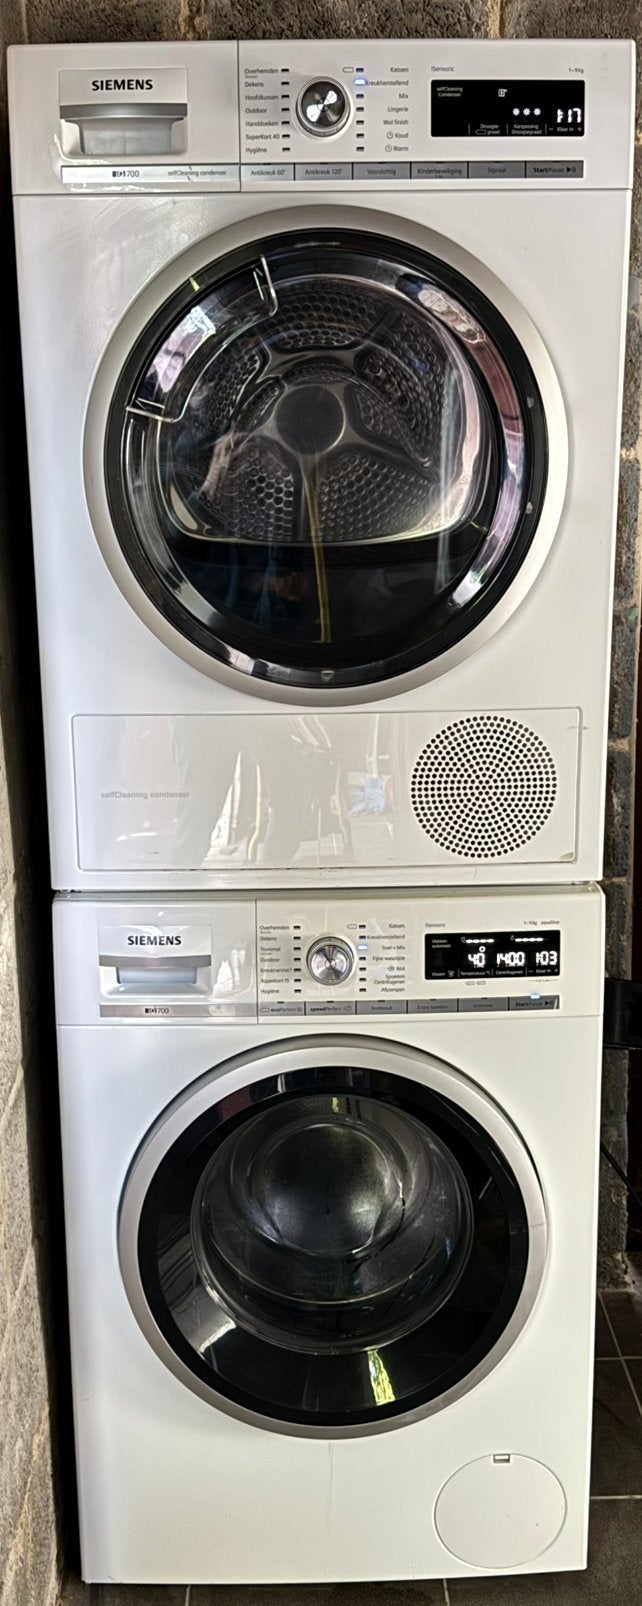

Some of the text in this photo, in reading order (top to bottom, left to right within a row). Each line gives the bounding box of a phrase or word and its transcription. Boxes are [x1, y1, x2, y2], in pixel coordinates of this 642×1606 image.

[92, 79, 153, 90] SIEMENS
[101, 790, 190, 800] selfCleaning condenser
[128, 935, 181, 946] SIEMENS
[496, 952, 525, 966] 1400
